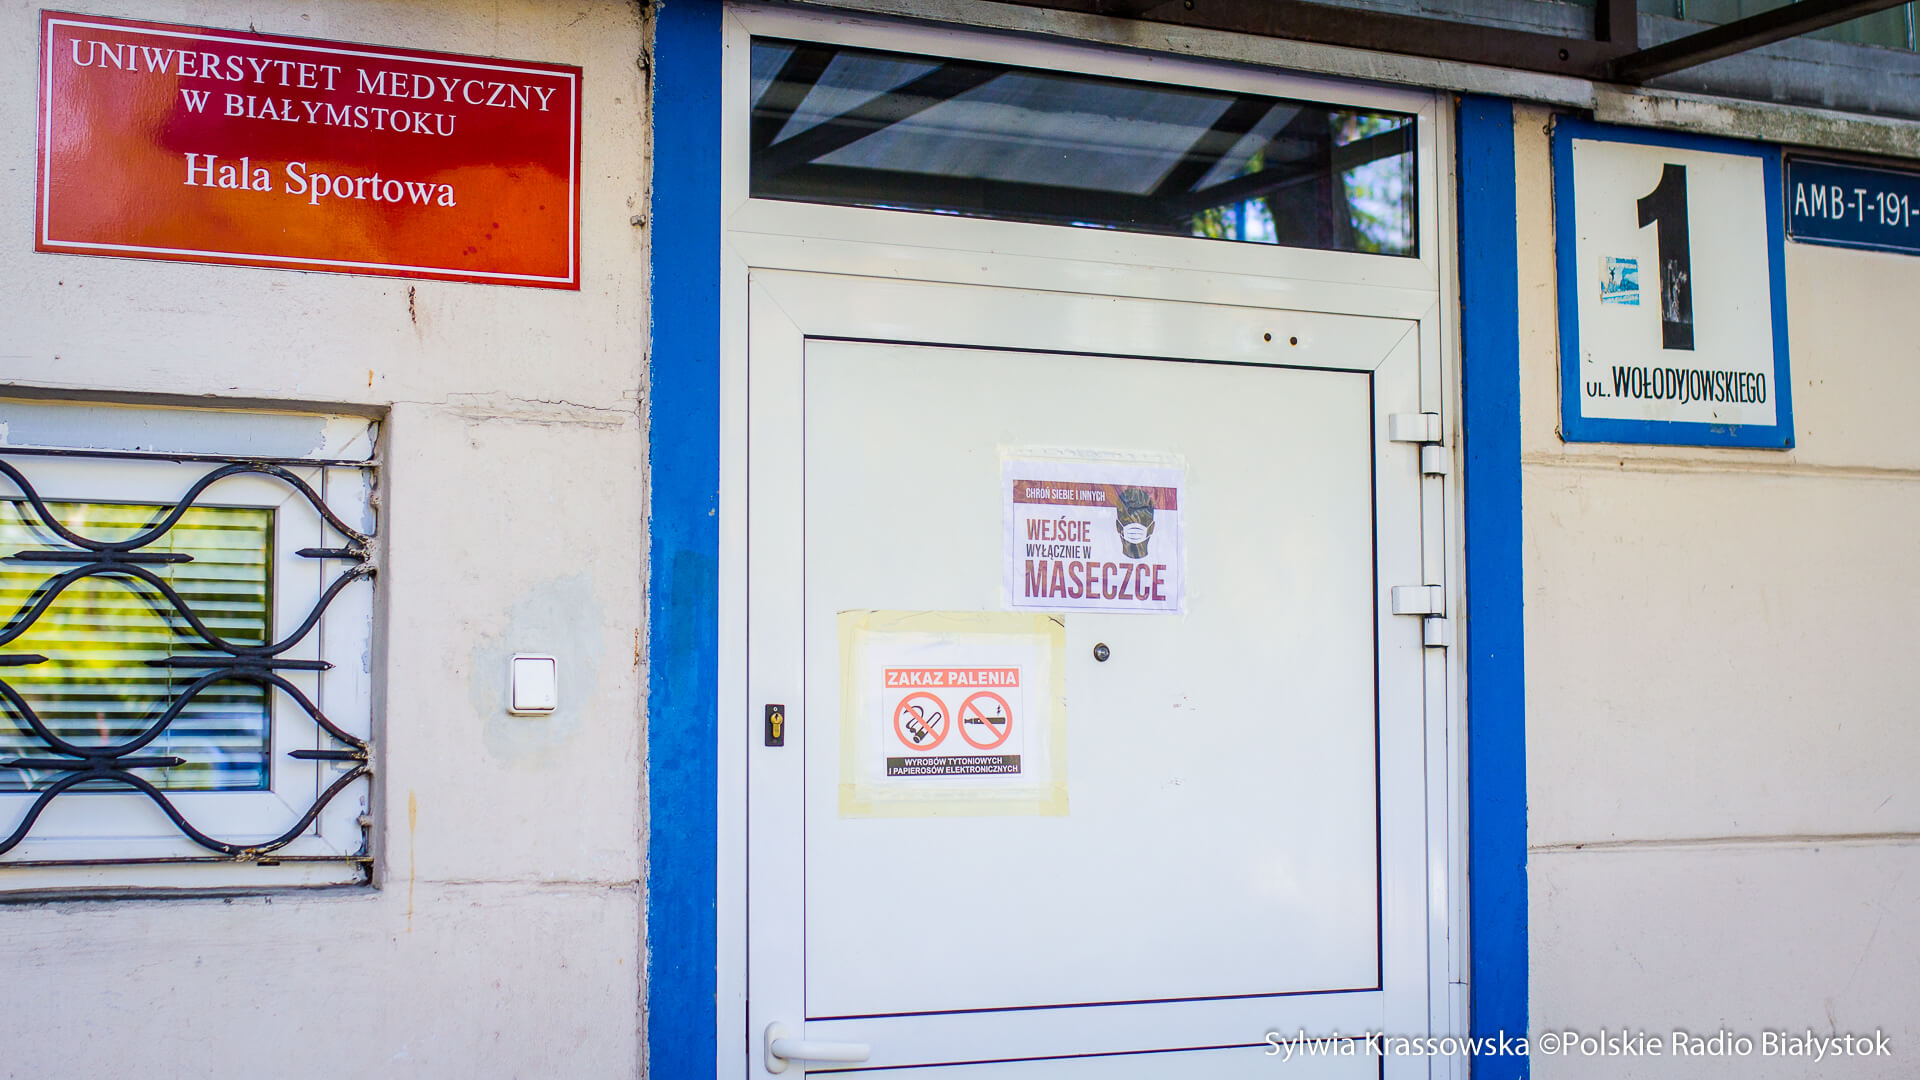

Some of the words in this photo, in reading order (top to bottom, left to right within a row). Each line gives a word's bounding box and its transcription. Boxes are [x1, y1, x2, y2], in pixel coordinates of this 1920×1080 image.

[70, 38, 342, 91] UNIWERSYTET
[356, 68, 556, 112] MEDYCZNY
[180, 88, 211, 114] W
[224, 93, 456, 136] BIAŁYMSTOKU
[184, 152, 273, 192] Hala
[285, 161, 456, 207] Sportowa
[1636, 163, 1695, 351] 1
[1612, 365, 1767, 405] WOŁODYJOWSKIEGO
[1026, 487, 1051, 499] CHROŃ
[1051, 489, 1075, 500] SIEBIE
[1076, 490, 1079, 501] I
[1080, 490, 1105, 502] INNYCH
[1026, 516, 1091, 543] WEJŚCIE
[1026, 543, 1080, 560] WYŁĄCZNIE
[1083, 546, 1091, 559] W
[1025, 559, 1166, 601] MASECZCE
[887, 671, 944, 685] ZAKAZ
[948, 671, 1017, 685] PALENIA
[893, 766, 945, 775] PAPIEROSÓW
[945, 765, 1018, 774] ELEKTRONICZNYCH
[904, 757, 947, 766] WYROBÓW
[948, 757, 1003, 766] TYTONIOWYCH
